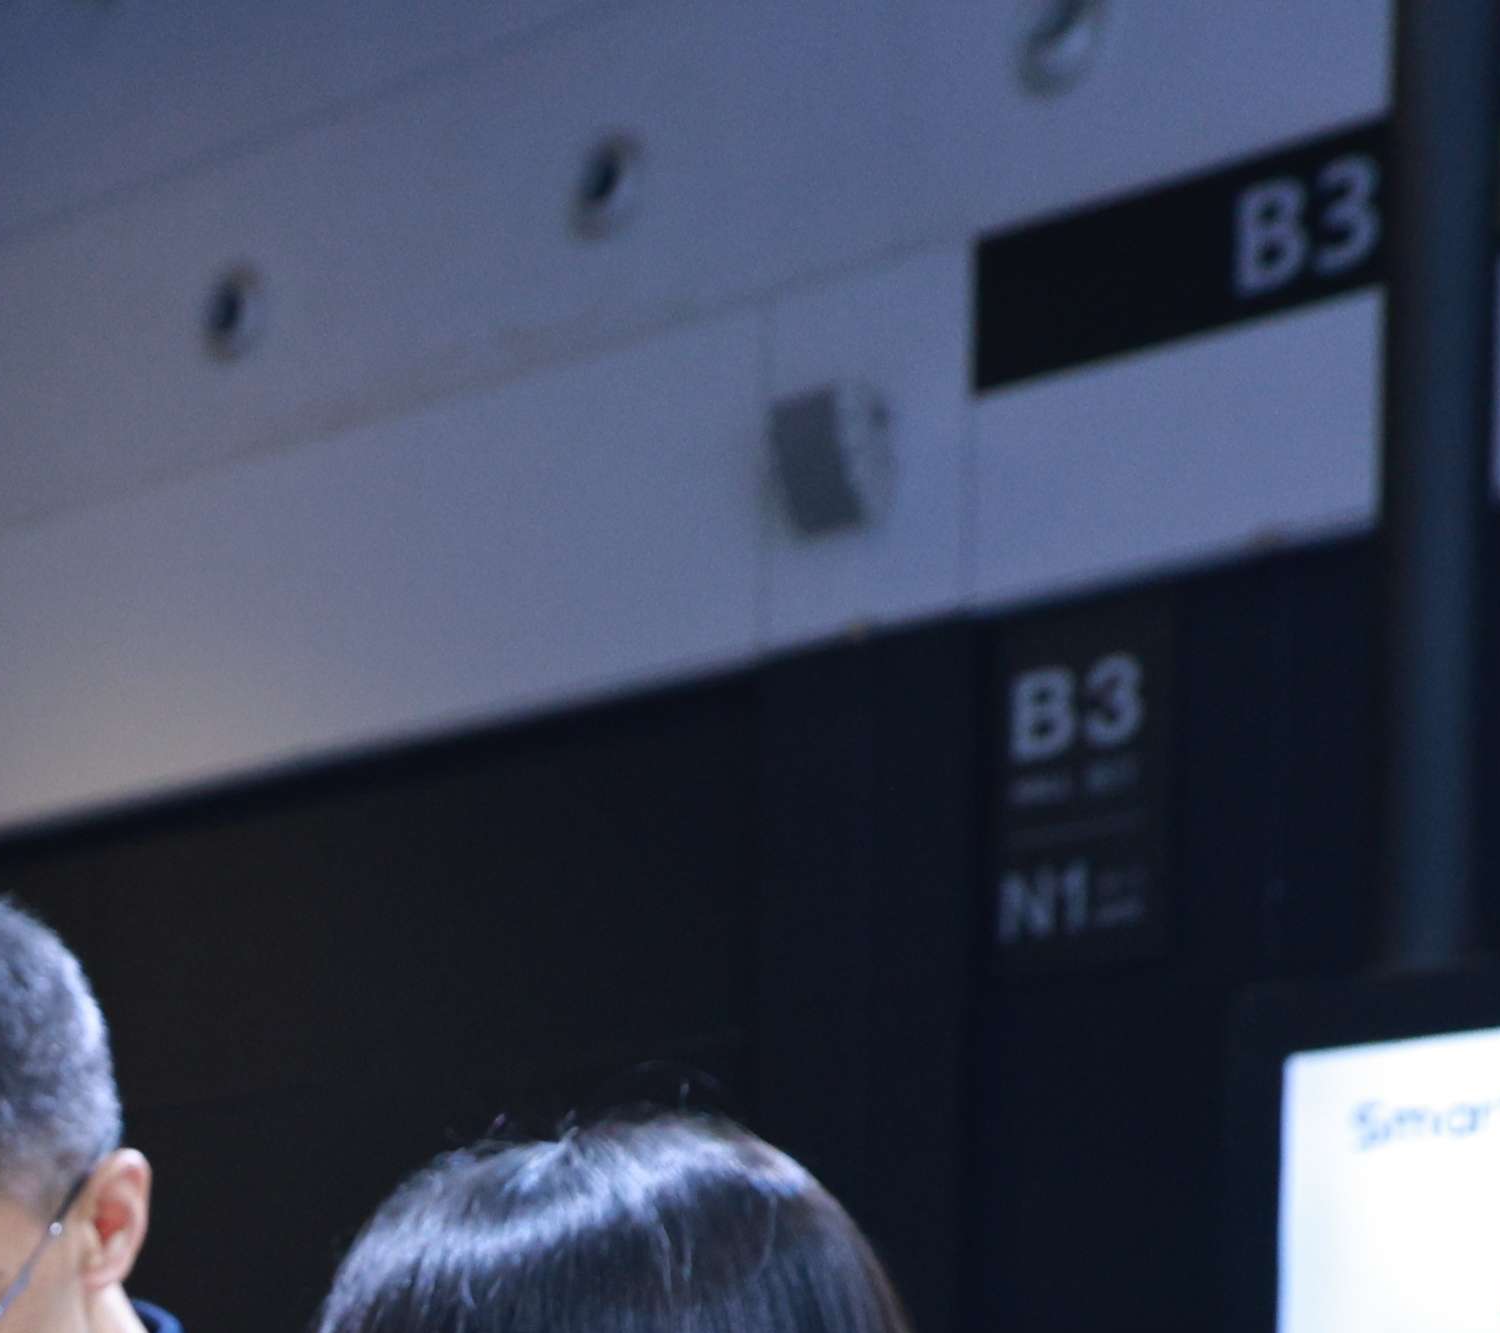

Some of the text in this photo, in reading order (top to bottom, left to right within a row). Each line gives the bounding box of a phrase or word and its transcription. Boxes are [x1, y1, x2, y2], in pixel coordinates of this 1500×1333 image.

[1230, 152, 1380, 298] B3
[1010, 655, 1144, 763] B3
[998, 860, 1089, 942] N1
